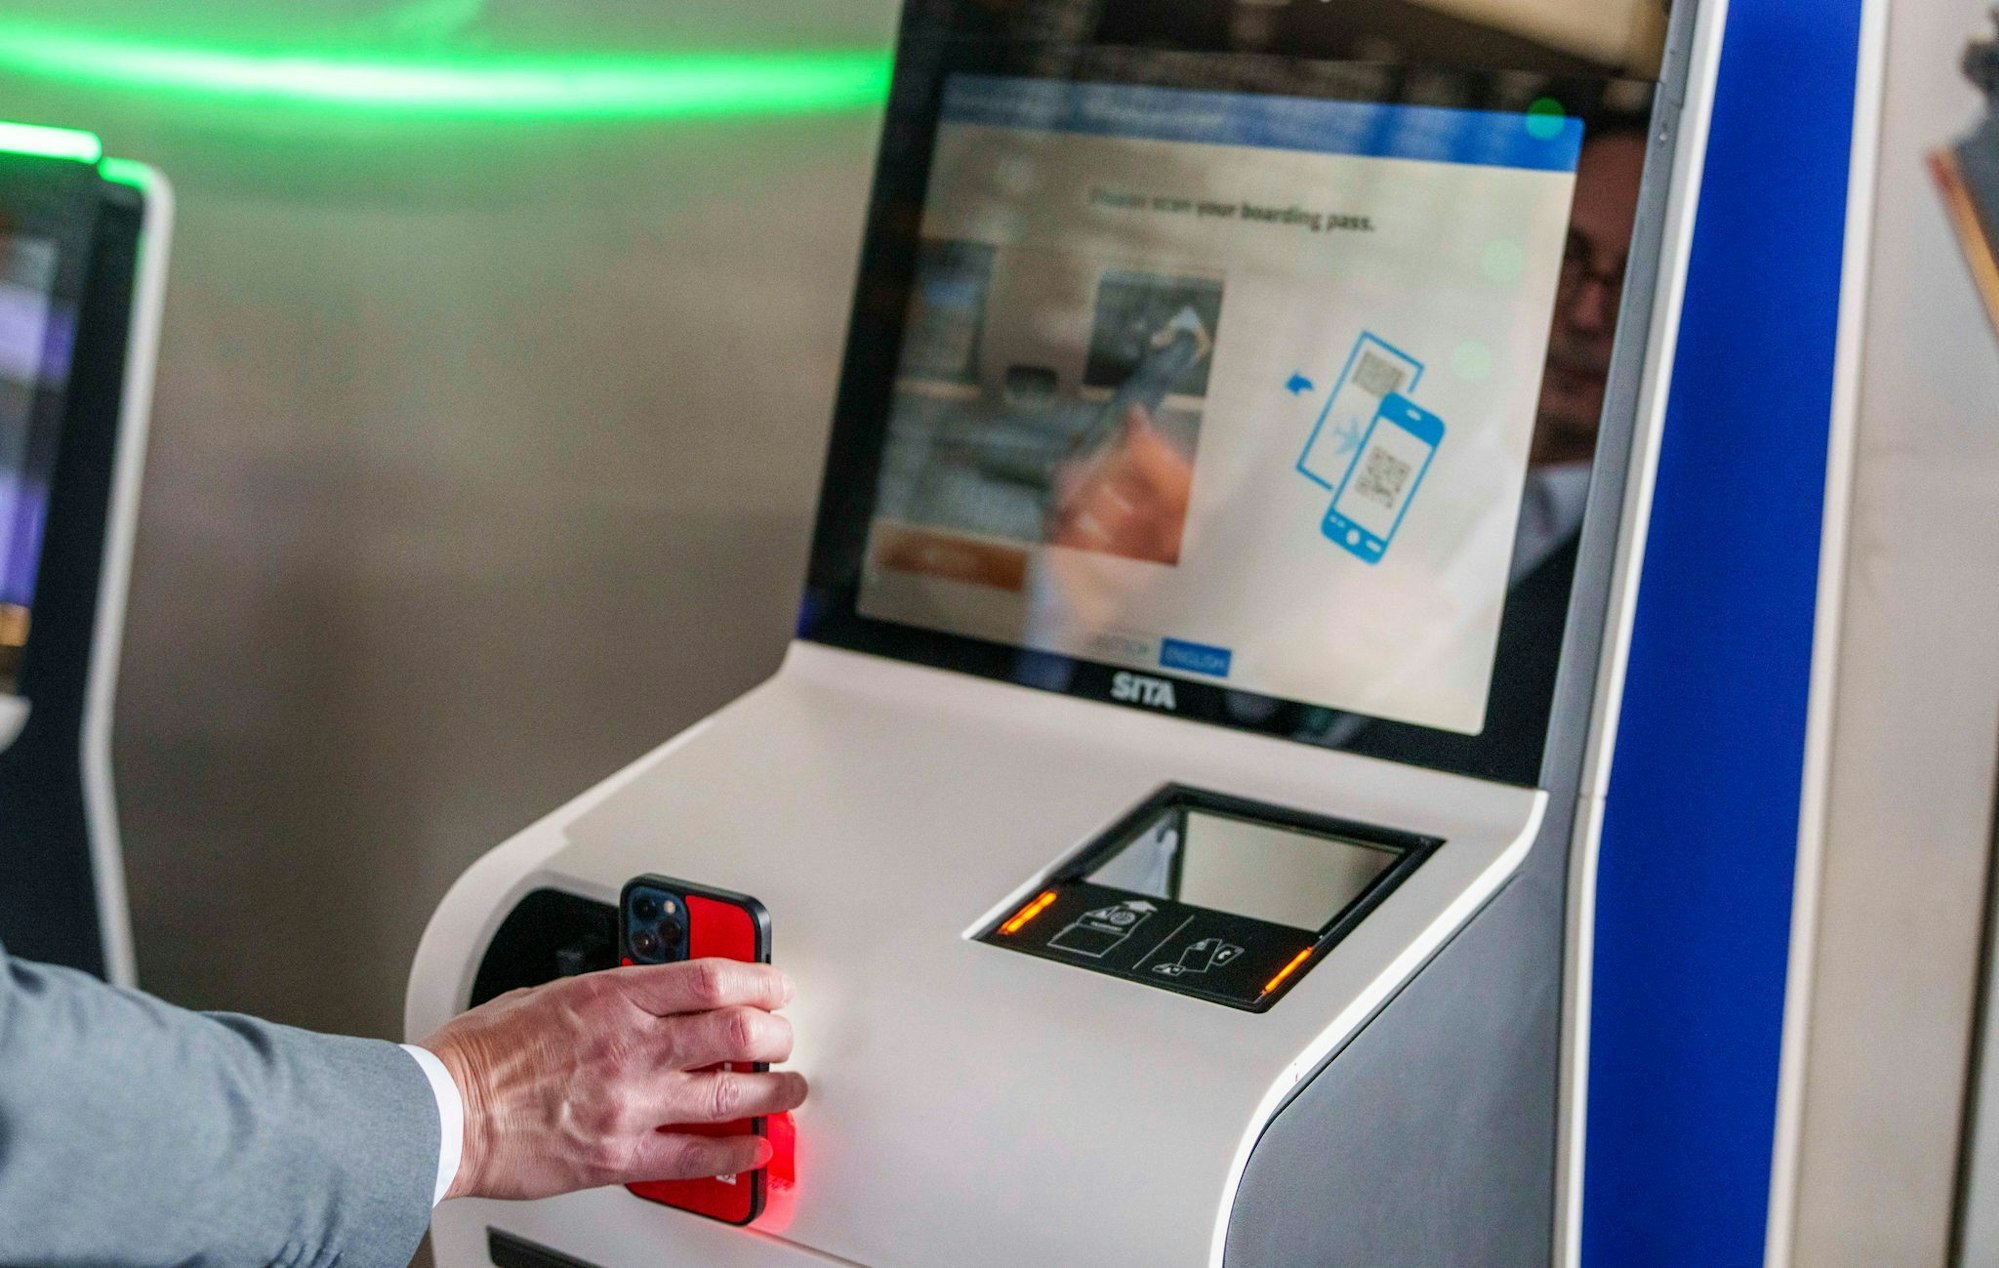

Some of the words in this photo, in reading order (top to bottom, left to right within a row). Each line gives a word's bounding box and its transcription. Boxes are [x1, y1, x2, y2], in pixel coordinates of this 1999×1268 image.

[1196, 200, 1236, 219] your
[1241, 199, 1322, 232] boarding
[1326, 213, 1376, 233] pass.
[1111, 670, 1178, 711] SITA
